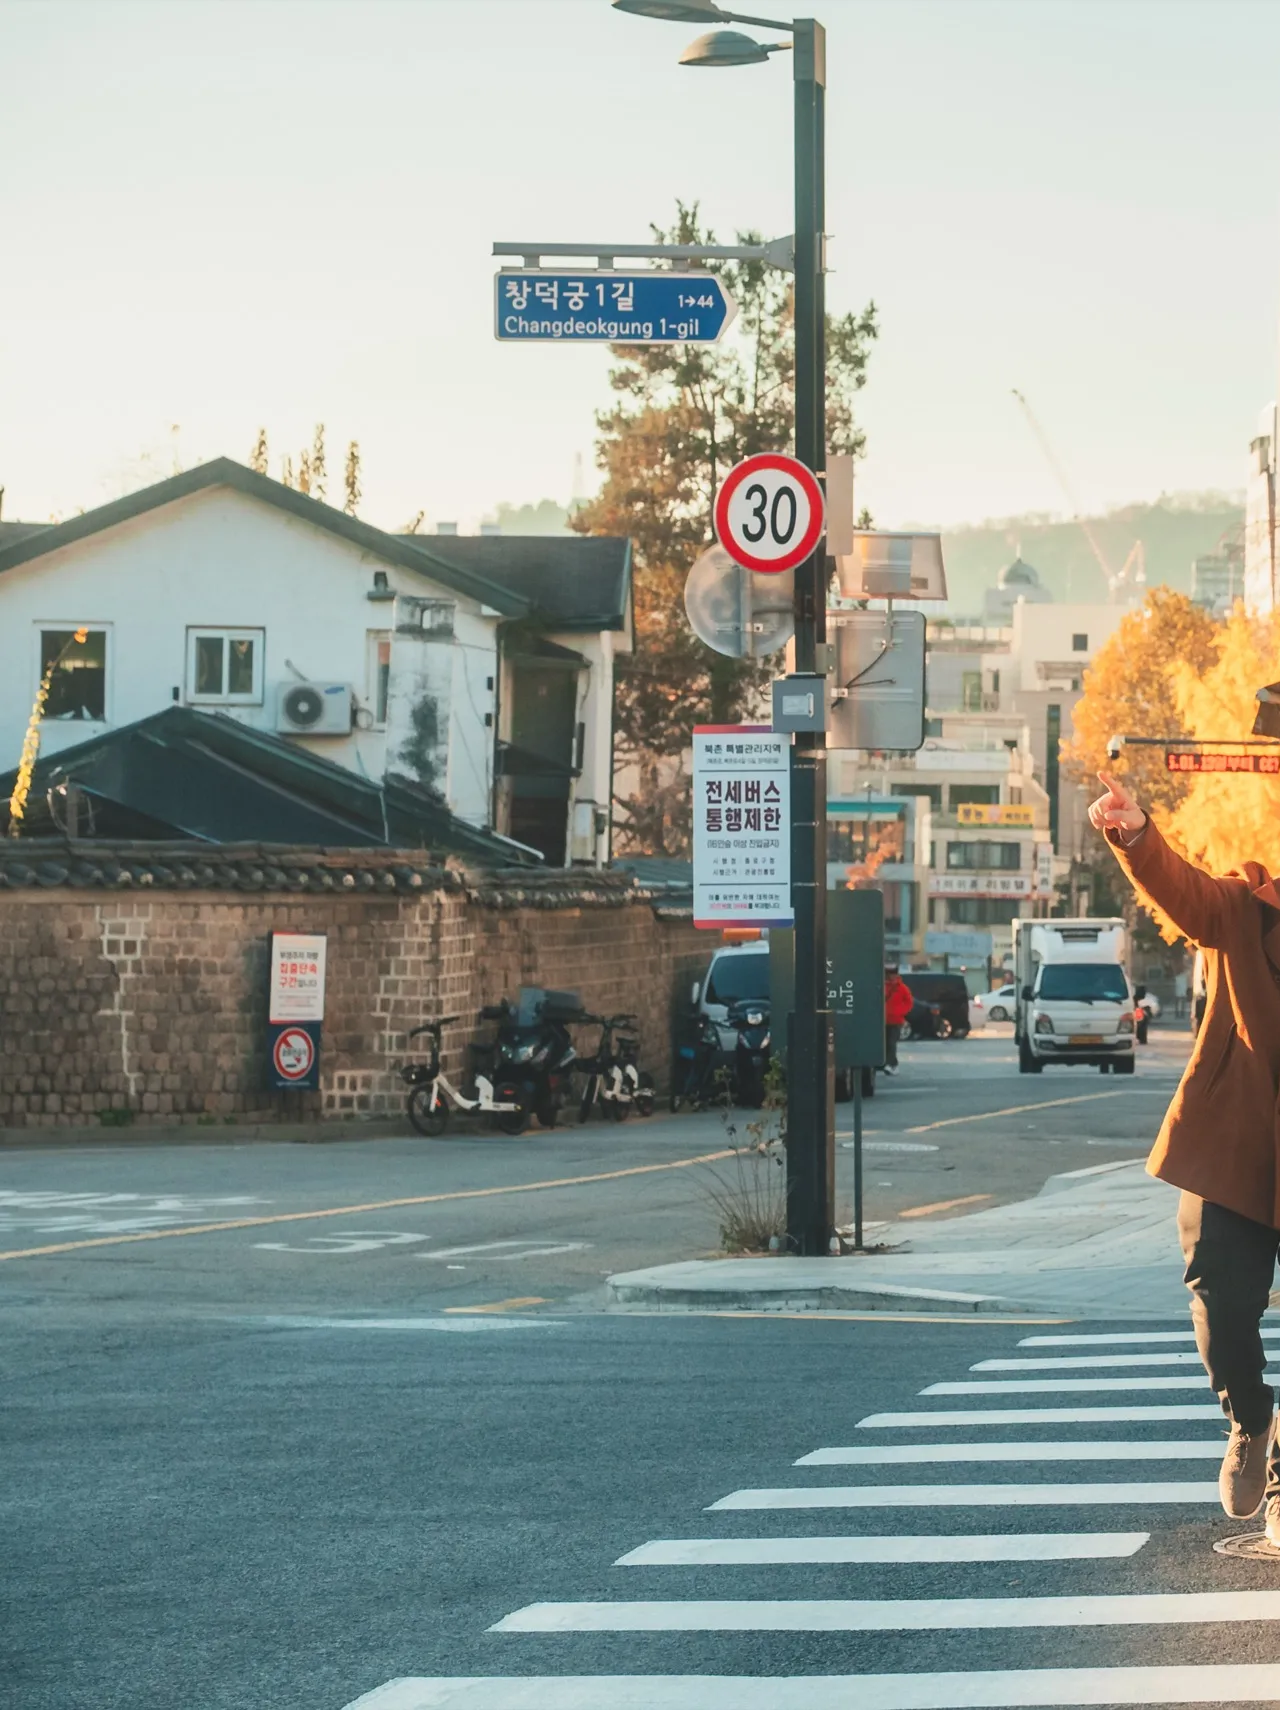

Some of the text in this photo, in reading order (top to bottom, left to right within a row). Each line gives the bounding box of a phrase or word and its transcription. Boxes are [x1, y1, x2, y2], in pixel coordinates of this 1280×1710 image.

[505, 281, 634, 312] 창덕궁1길
[505, 316, 700, 339] Changdeokgung 1-gil
[742, 484, 797, 546] 30
[706, 780, 781, 804] 전세버스
[706, 807, 781, 832] 통행제한
